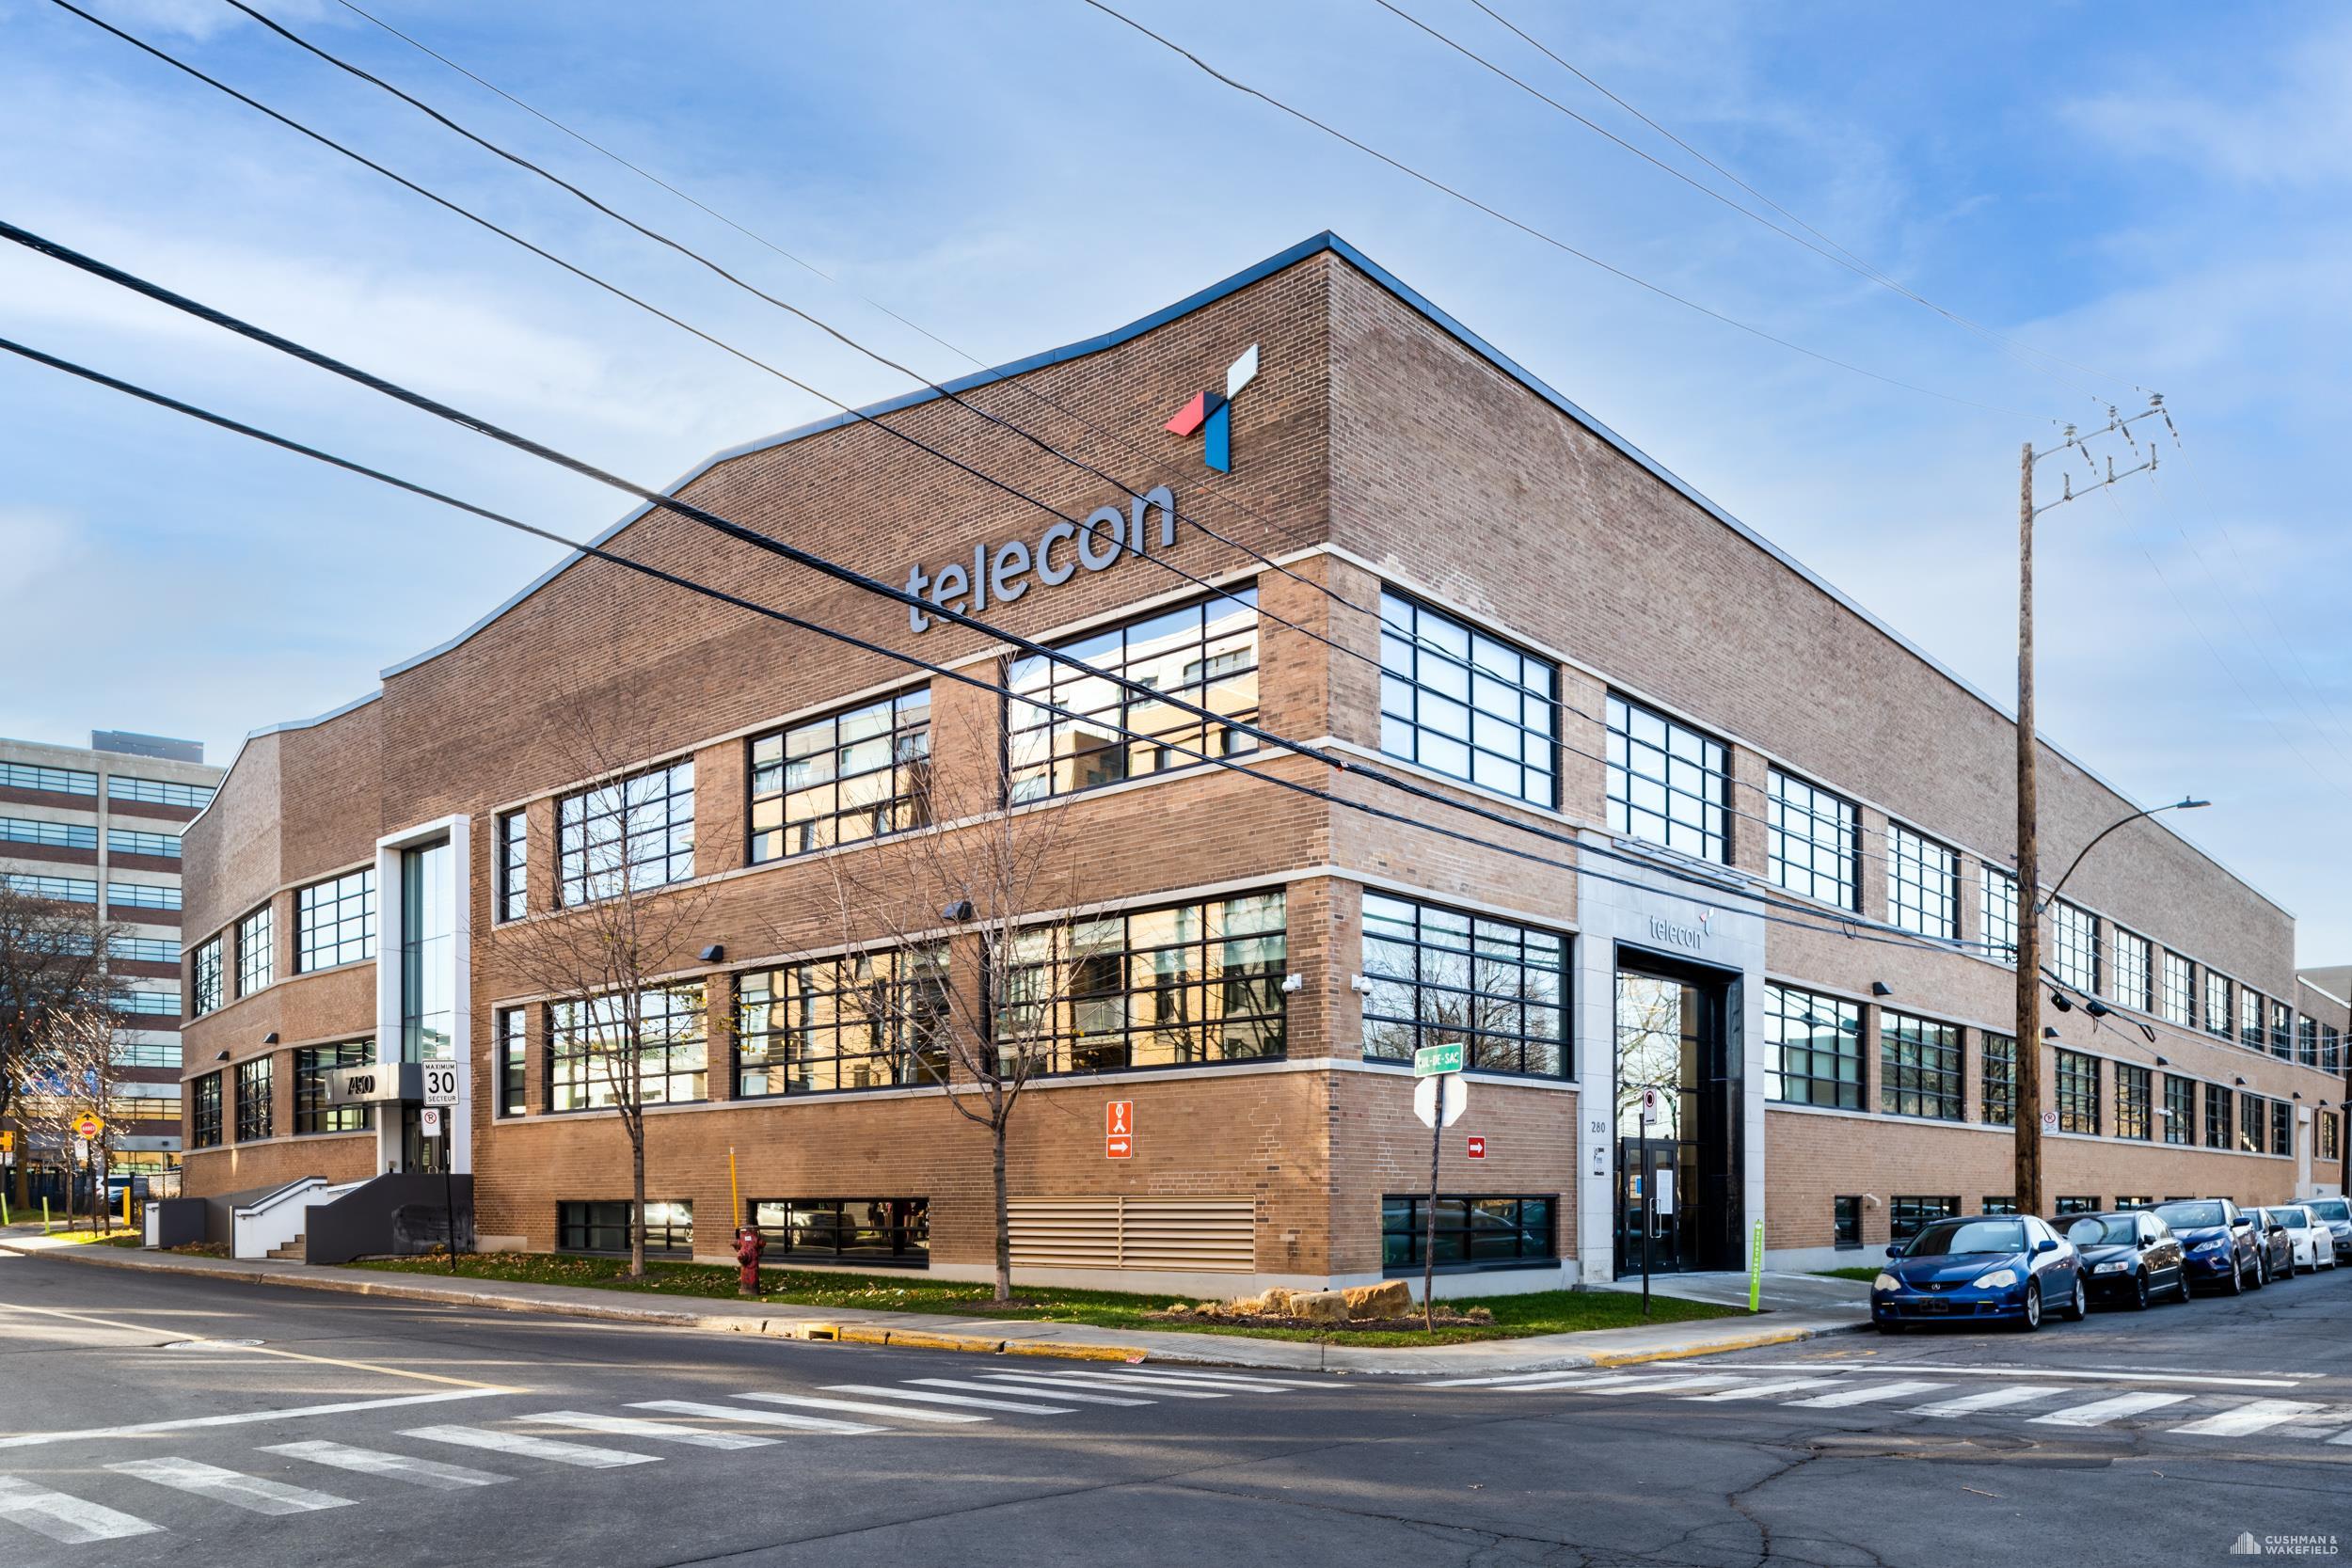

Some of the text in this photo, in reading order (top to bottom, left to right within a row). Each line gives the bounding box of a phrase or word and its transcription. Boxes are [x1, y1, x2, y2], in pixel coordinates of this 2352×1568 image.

[906, 485, 1176, 633] telecon
[1650, 915, 1702, 950] telecon
[1418, 1052, 1460, 1069] CUL-DE-SAC
[428, 1072, 454, 1094] 30
[1591, 1121, 1606, 1133] 280
